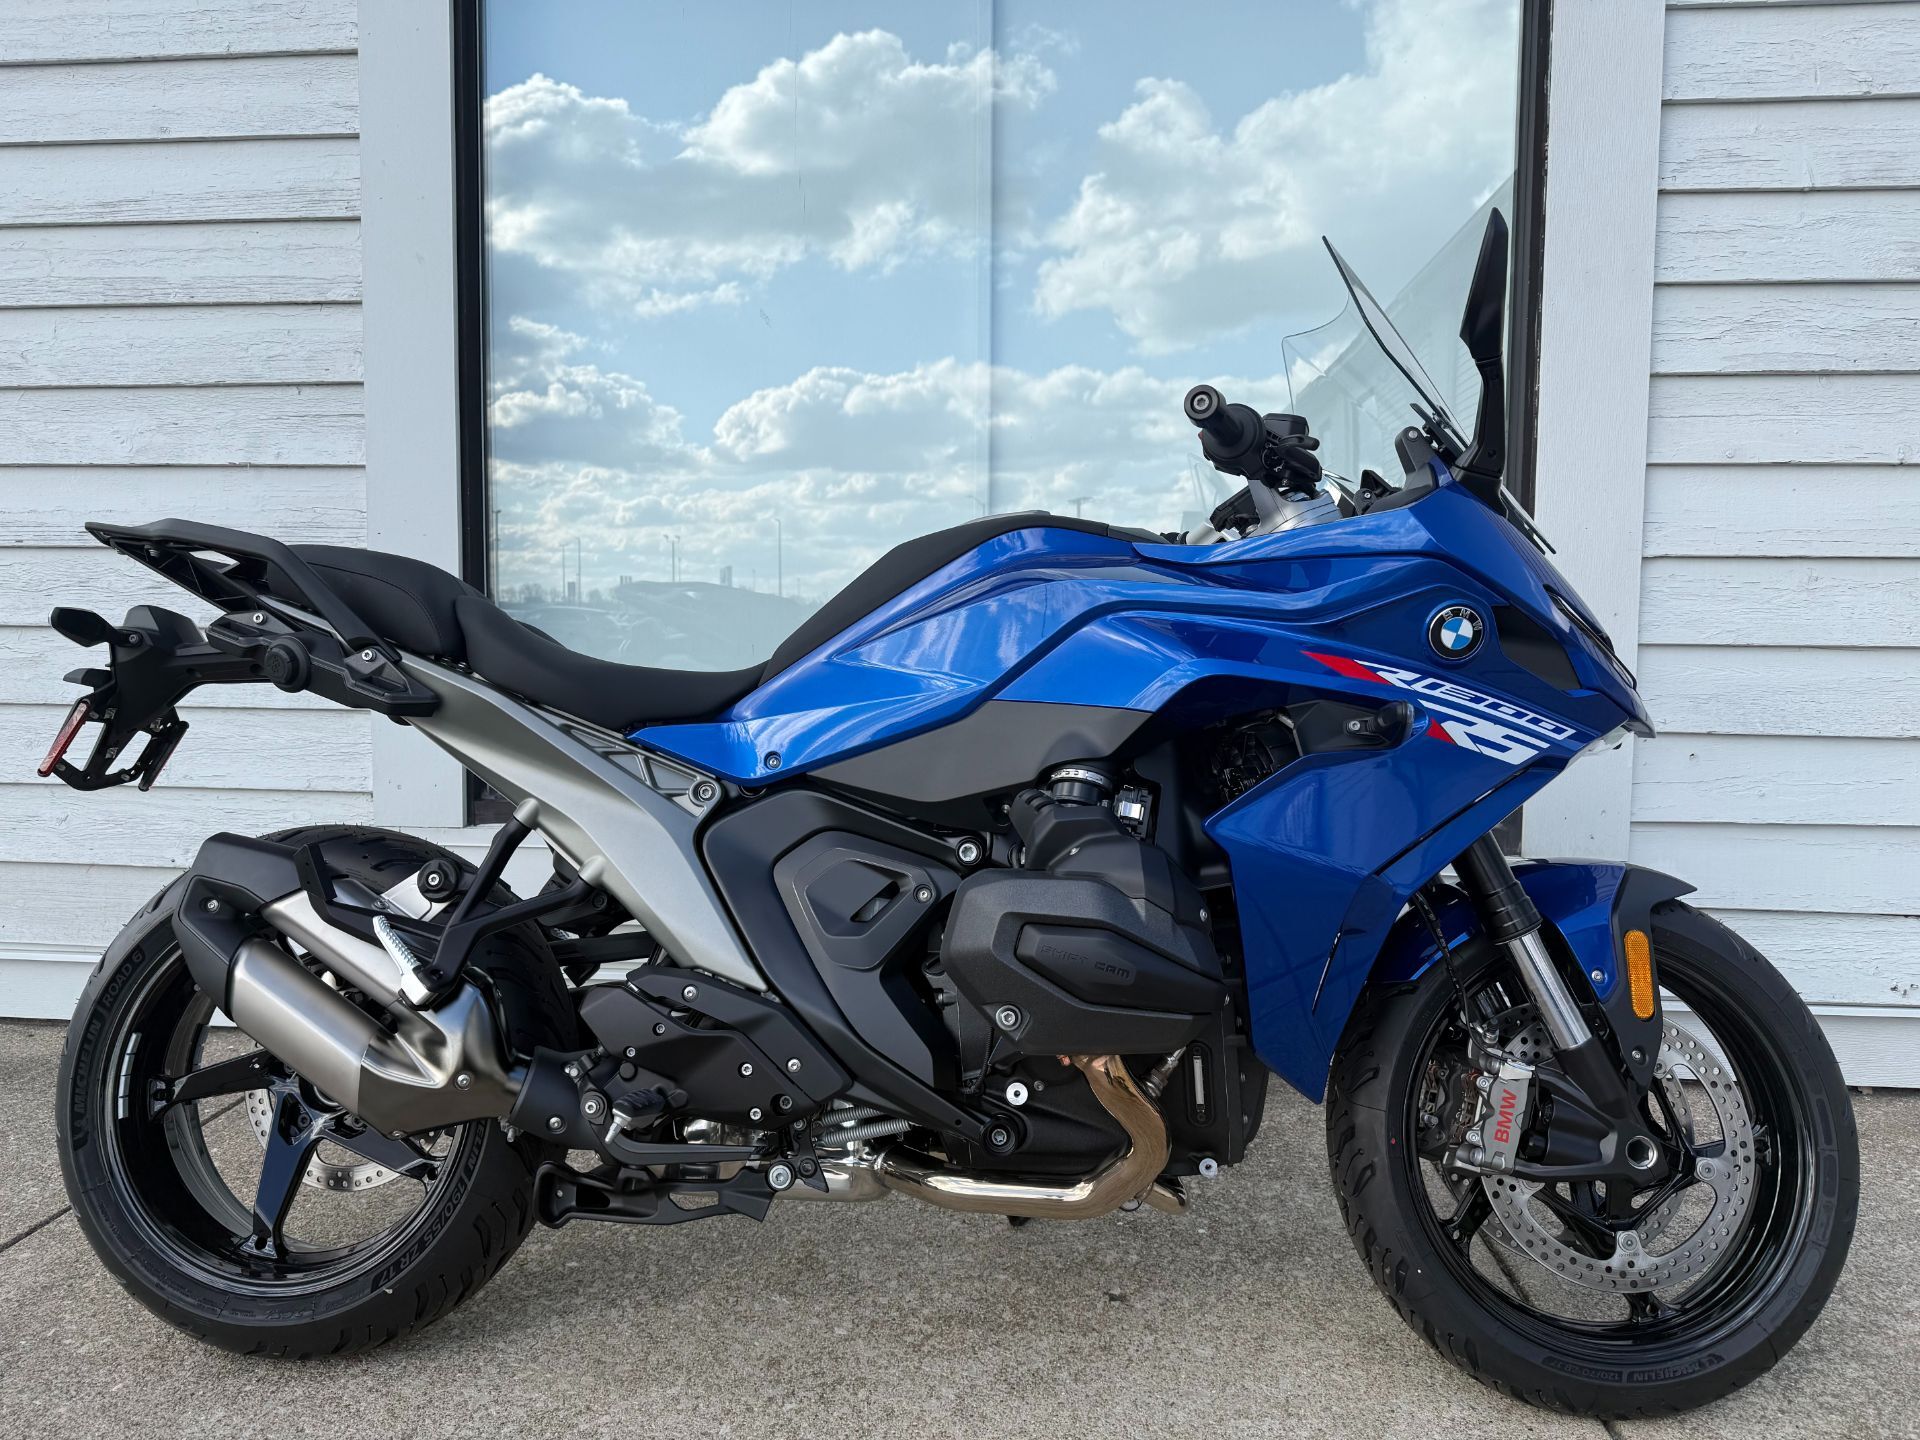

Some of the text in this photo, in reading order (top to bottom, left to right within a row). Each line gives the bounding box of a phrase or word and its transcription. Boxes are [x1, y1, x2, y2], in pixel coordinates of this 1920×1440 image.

[1441, 608, 1483, 631] BMW
[1417, 698, 1551, 765] RS
[73, 949, 143, 1115] MICHELIN ROAD 6
[1493, 1088, 1517, 1144] BMW
[423, 1179, 467, 1245] 190/55
[377, 1266, 397, 1287] 17
[400, 1242, 421, 1270] ZR
[1634, 1360, 1701, 1382] MICHELIN
